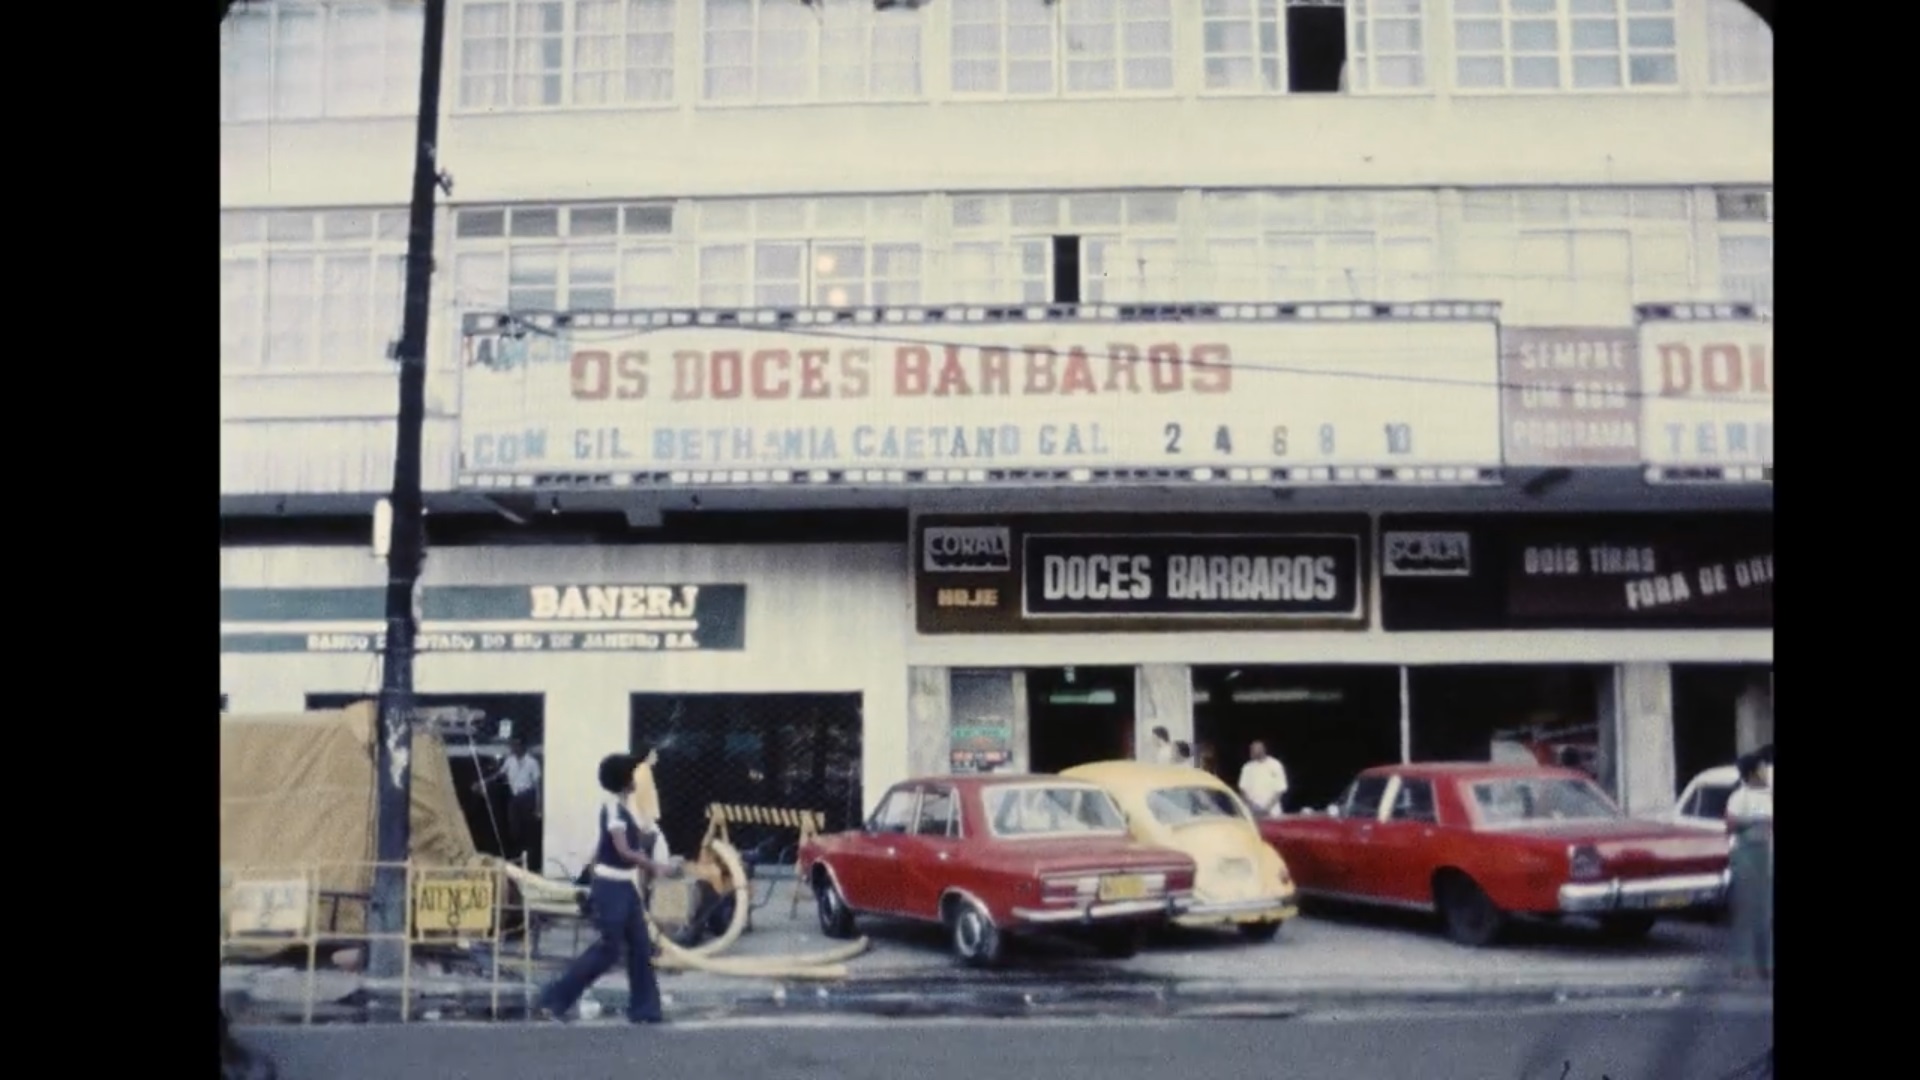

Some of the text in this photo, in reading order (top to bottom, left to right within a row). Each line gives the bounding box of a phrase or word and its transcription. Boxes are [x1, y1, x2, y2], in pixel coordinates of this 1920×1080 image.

[1519, 340, 1629, 370] SEMPRE
[570, 349, 650, 401] OS
[672, 347, 871, 401] DOCES
[895, 342, 1232, 397] BARBAROS
[473, 428, 547, 464] COM
[573, 427, 632, 459] GIL
[852, 424, 1021, 458] CAETANO
[1038, 423, 1109, 455] GAL
[1163, 422, 1182, 454] 2
[1214, 423, 1233, 454] 4
[1272, 424, 1288, 455] 6
[1319, 422, 1335, 454] 8
[1385, 422, 1412, 454] 10
[930, 535, 1004, 556] CORAL
[1590, 546, 1655, 574] TIRAS
[1043, 553, 1336, 601] DOCES BARBAROS
[1625, 571, 1690, 611] FORA
[1699, 563, 1727, 595] DE
[530, 585, 699, 619] BANERJ
[937, 588, 998, 607] HOJE
[307, 633, 370, 650] BANCO
